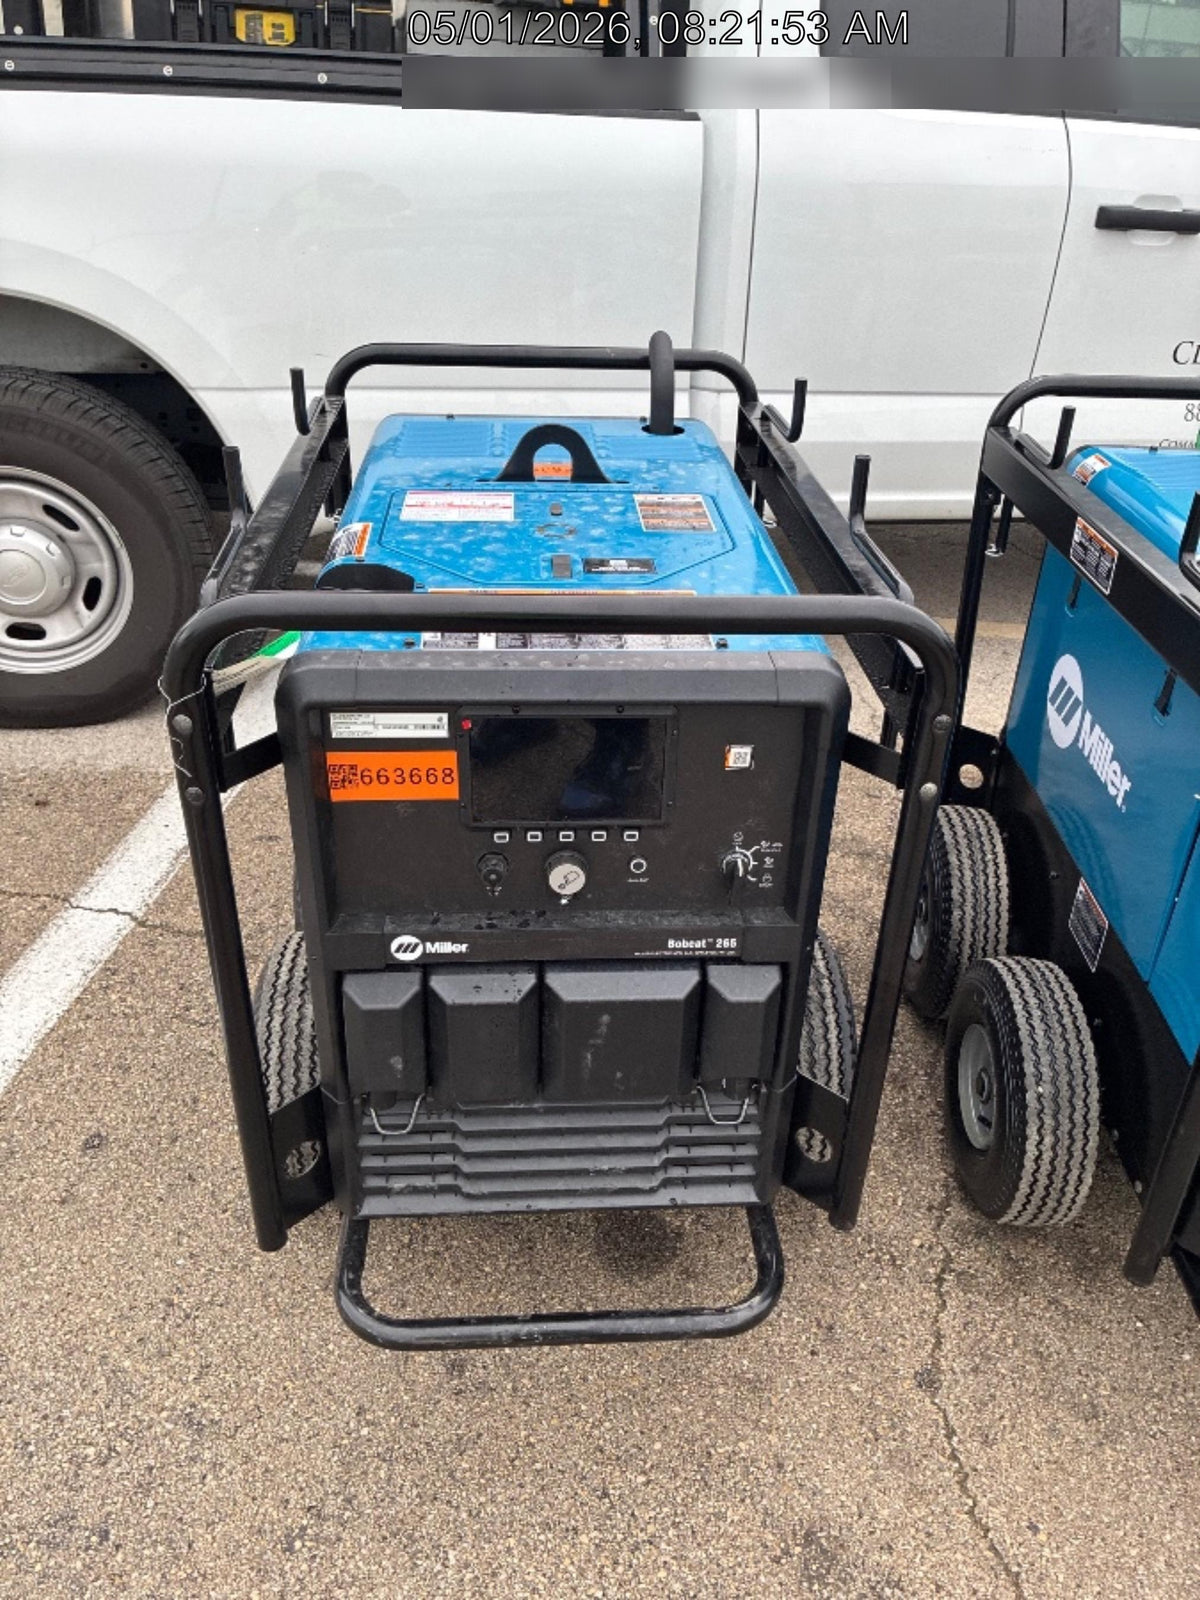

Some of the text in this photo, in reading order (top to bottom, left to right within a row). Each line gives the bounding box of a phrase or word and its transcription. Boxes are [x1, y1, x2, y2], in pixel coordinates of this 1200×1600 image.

[1078, 709, 1133, 808] Miller
[360, 767, 455, 786] 663668
[425, 941, 469, 954] Miller
